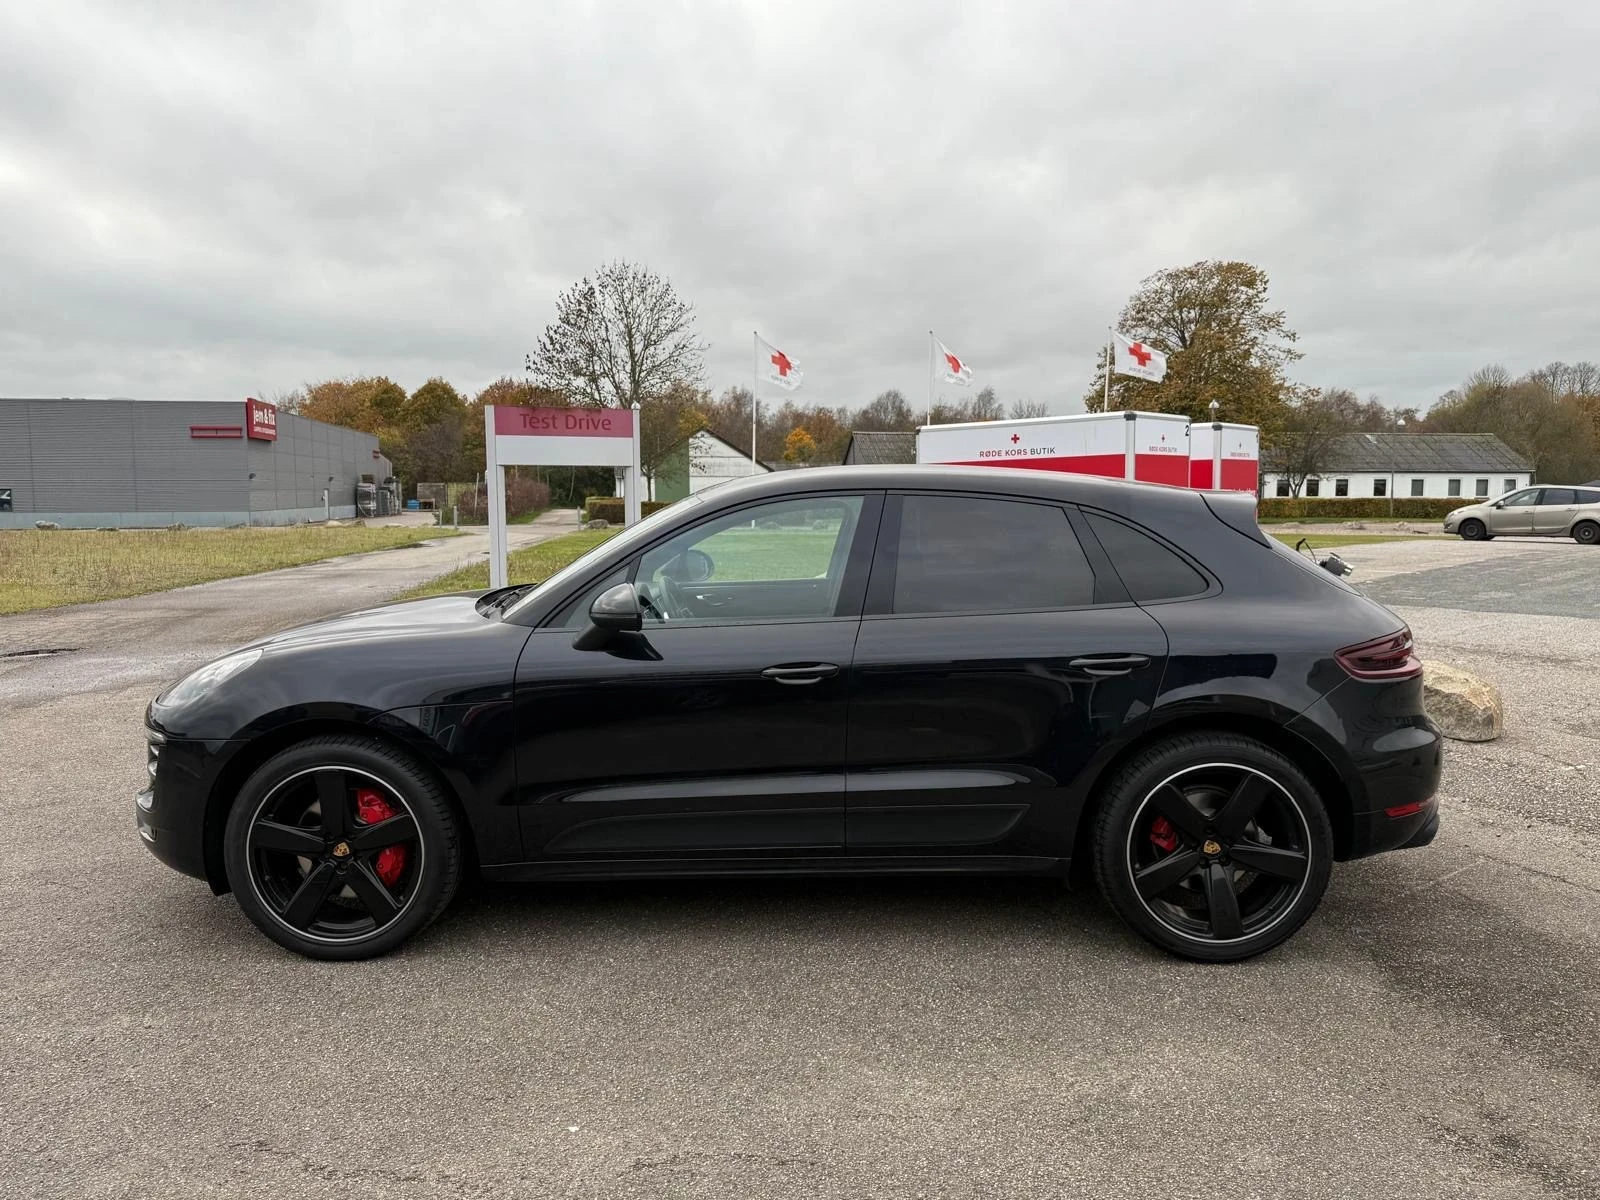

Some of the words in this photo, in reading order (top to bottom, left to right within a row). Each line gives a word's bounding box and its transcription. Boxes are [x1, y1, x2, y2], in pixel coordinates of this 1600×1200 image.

[264, 408, 268, 424] &
[520, 413, 558, 429] Test
[565, 414, 612, 431] Drive
[1184, 424, 1190, 437] 2
[979, 450, 1003, 458] RØDE
[1005, 448, 1028, 457] KORS
[1030, 447, 1056, 456] BUTIK
